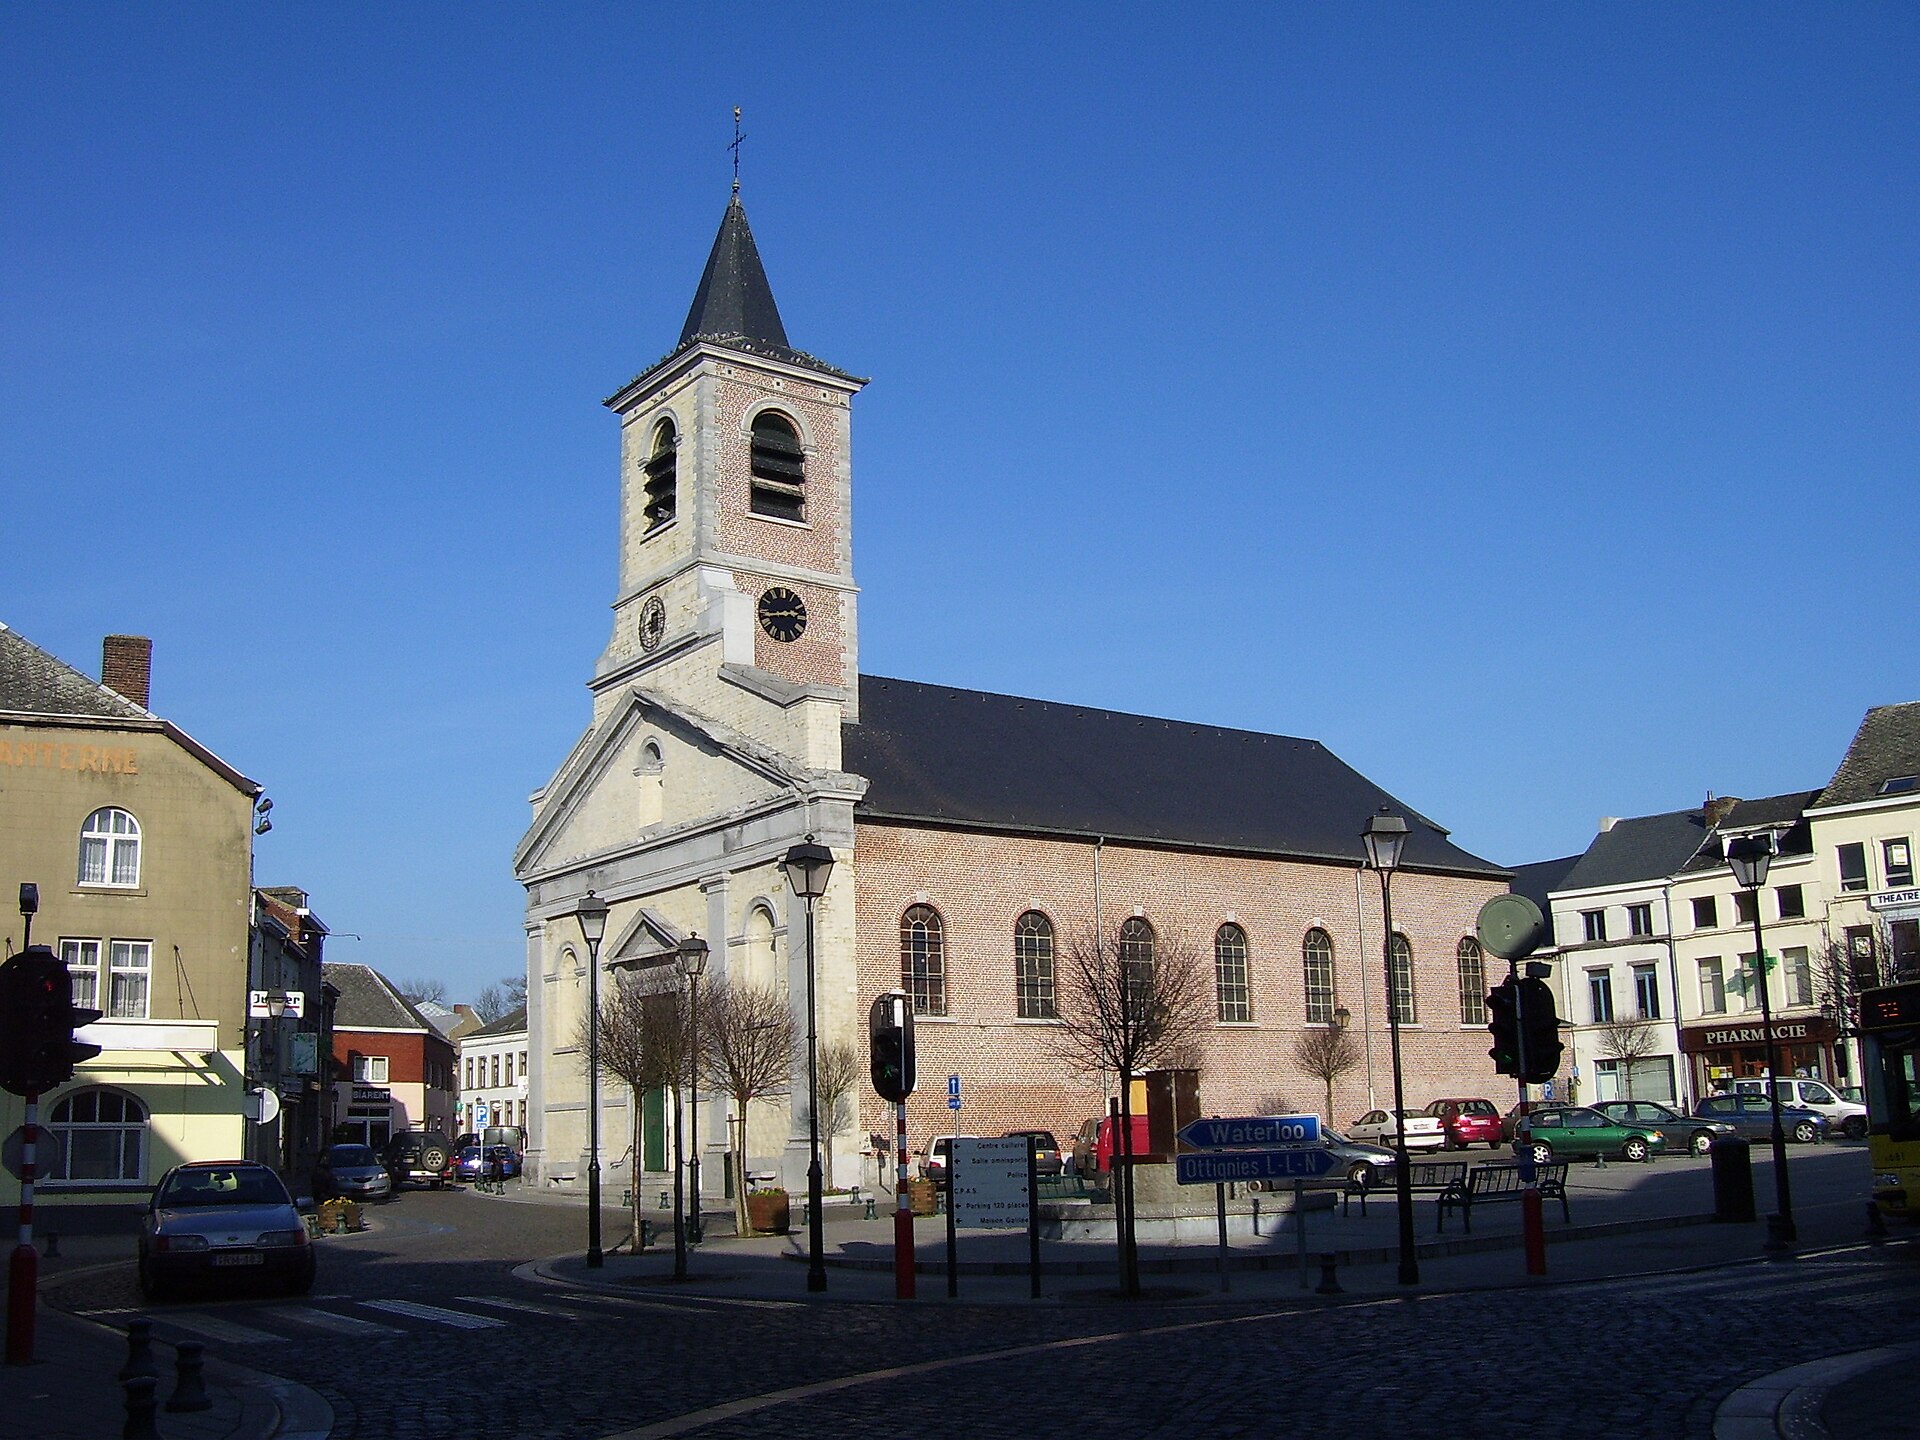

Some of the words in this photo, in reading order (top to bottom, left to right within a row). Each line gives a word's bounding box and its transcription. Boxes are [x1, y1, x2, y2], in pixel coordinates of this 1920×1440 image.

[1877, 891, 1919, 903] THEATRE
[477, 1107, 487, 1121] P
[1209, 1121, 1305, 1143] Waterloo
[1186, 1157, 1260, 1179] Ottignies
[1267, 1153, 1316, 1175] L-L-N
[966, 1202, 991, 1210] Parking
